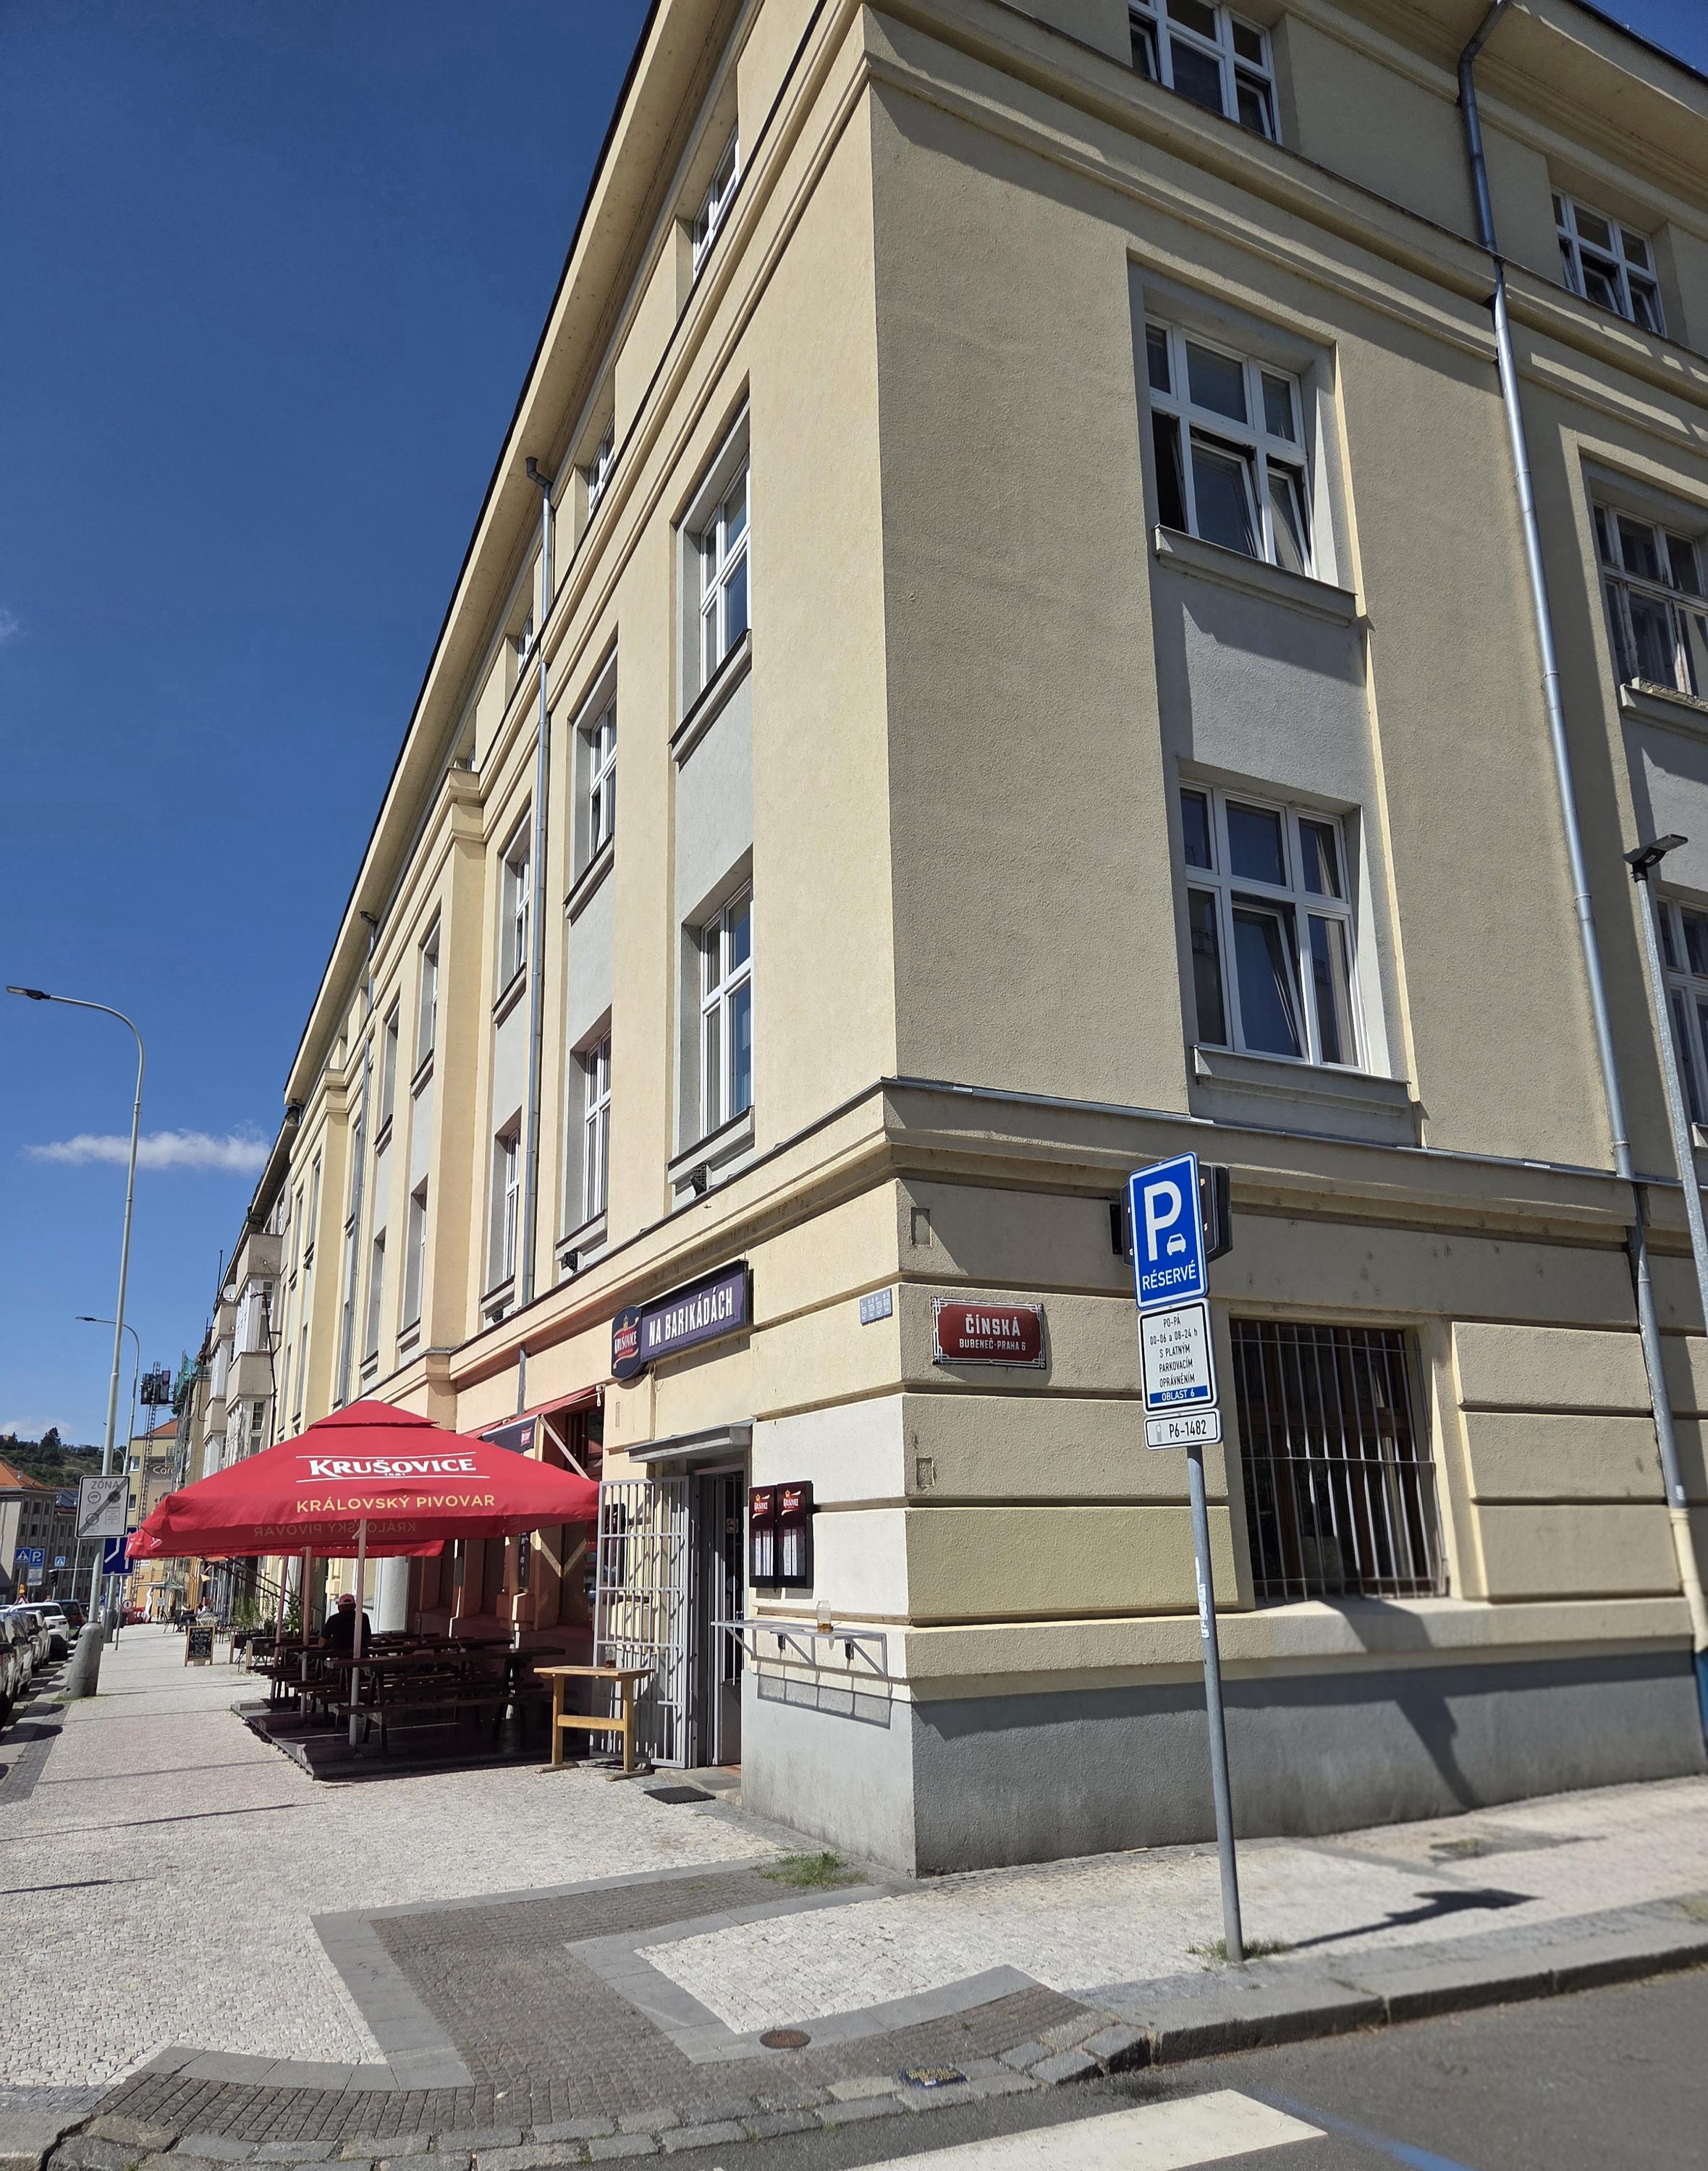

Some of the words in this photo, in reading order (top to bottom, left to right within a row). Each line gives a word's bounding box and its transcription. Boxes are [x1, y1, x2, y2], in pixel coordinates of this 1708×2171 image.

[1143, 1180, 1182, 1261] P
[1142, 1260, 1197, 1290] RÉSERVÉ
[648, 1319, 661, 1347] NA
[664, 1286, 732, 1341] BARIKÁDÁCH
[965, 1313, 1020, 1336] ČÍNSKÁ
[1163, 1313, 1181, 1328] PO-PÁ
[1149, 1333, 1167, 1345] 00-06
[1174, 1329, 1191, 1340] 08-24
[1193, 1327, 1198, 1337] h
[1021, 1341, 1026, 1351] 6
[1159, 1349, 1164, 1358] S
[1165, 1342, 1191, 1358] PLATNÝM
[1159, 1356, 1193, 1373] PARKOVACÍM
[1159, 1371, 1195, 1388] OPRÁVNĚNÍM
[1162, 1389, 1188, 1402] OBLAST
[1190, 1388, 1195, 1397] 6
[1169, 1419, 1207, 1439] P6-1482
[309, 1457, 477, 1478] KRUŠOVICE
[90, 1478, 119, 1489] ZÓNA
[296, 1494, 410, 1514] KRÁLOVSKÝ
[416, 1494, 496, 1509] PIVOVAR
